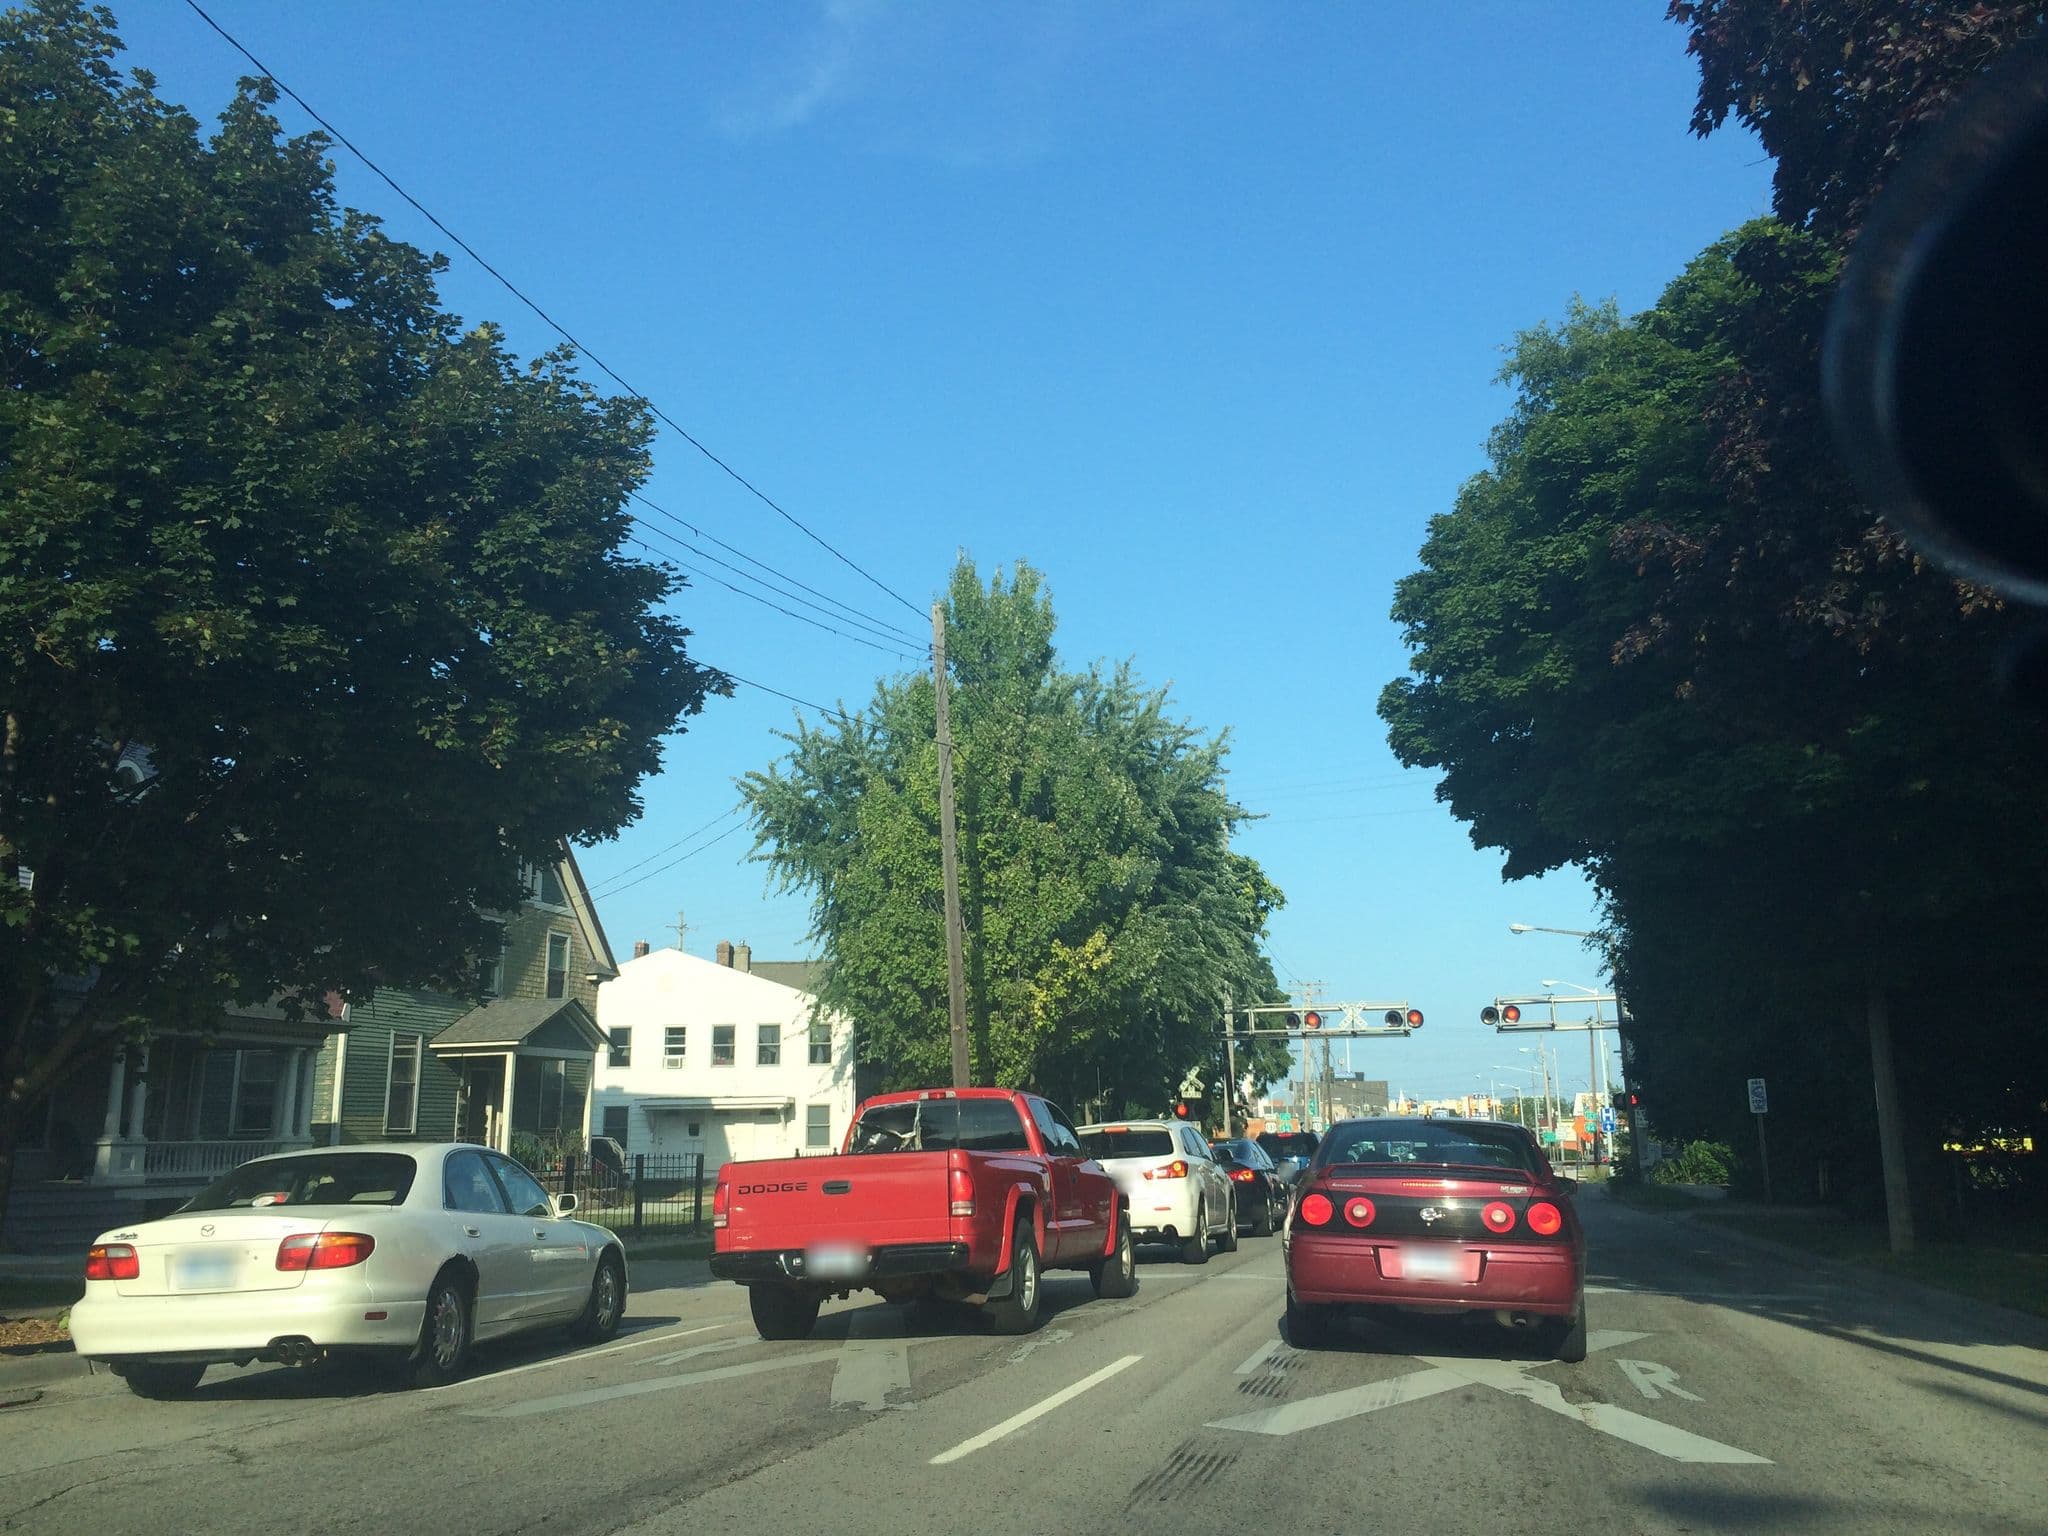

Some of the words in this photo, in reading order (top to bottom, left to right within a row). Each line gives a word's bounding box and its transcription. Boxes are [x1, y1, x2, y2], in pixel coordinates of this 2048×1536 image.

[1602, 1108, 1613, 1122] H
[737, 1182, 808, 1195] DODGE
[1614, 1358, 1706, 1402] R
